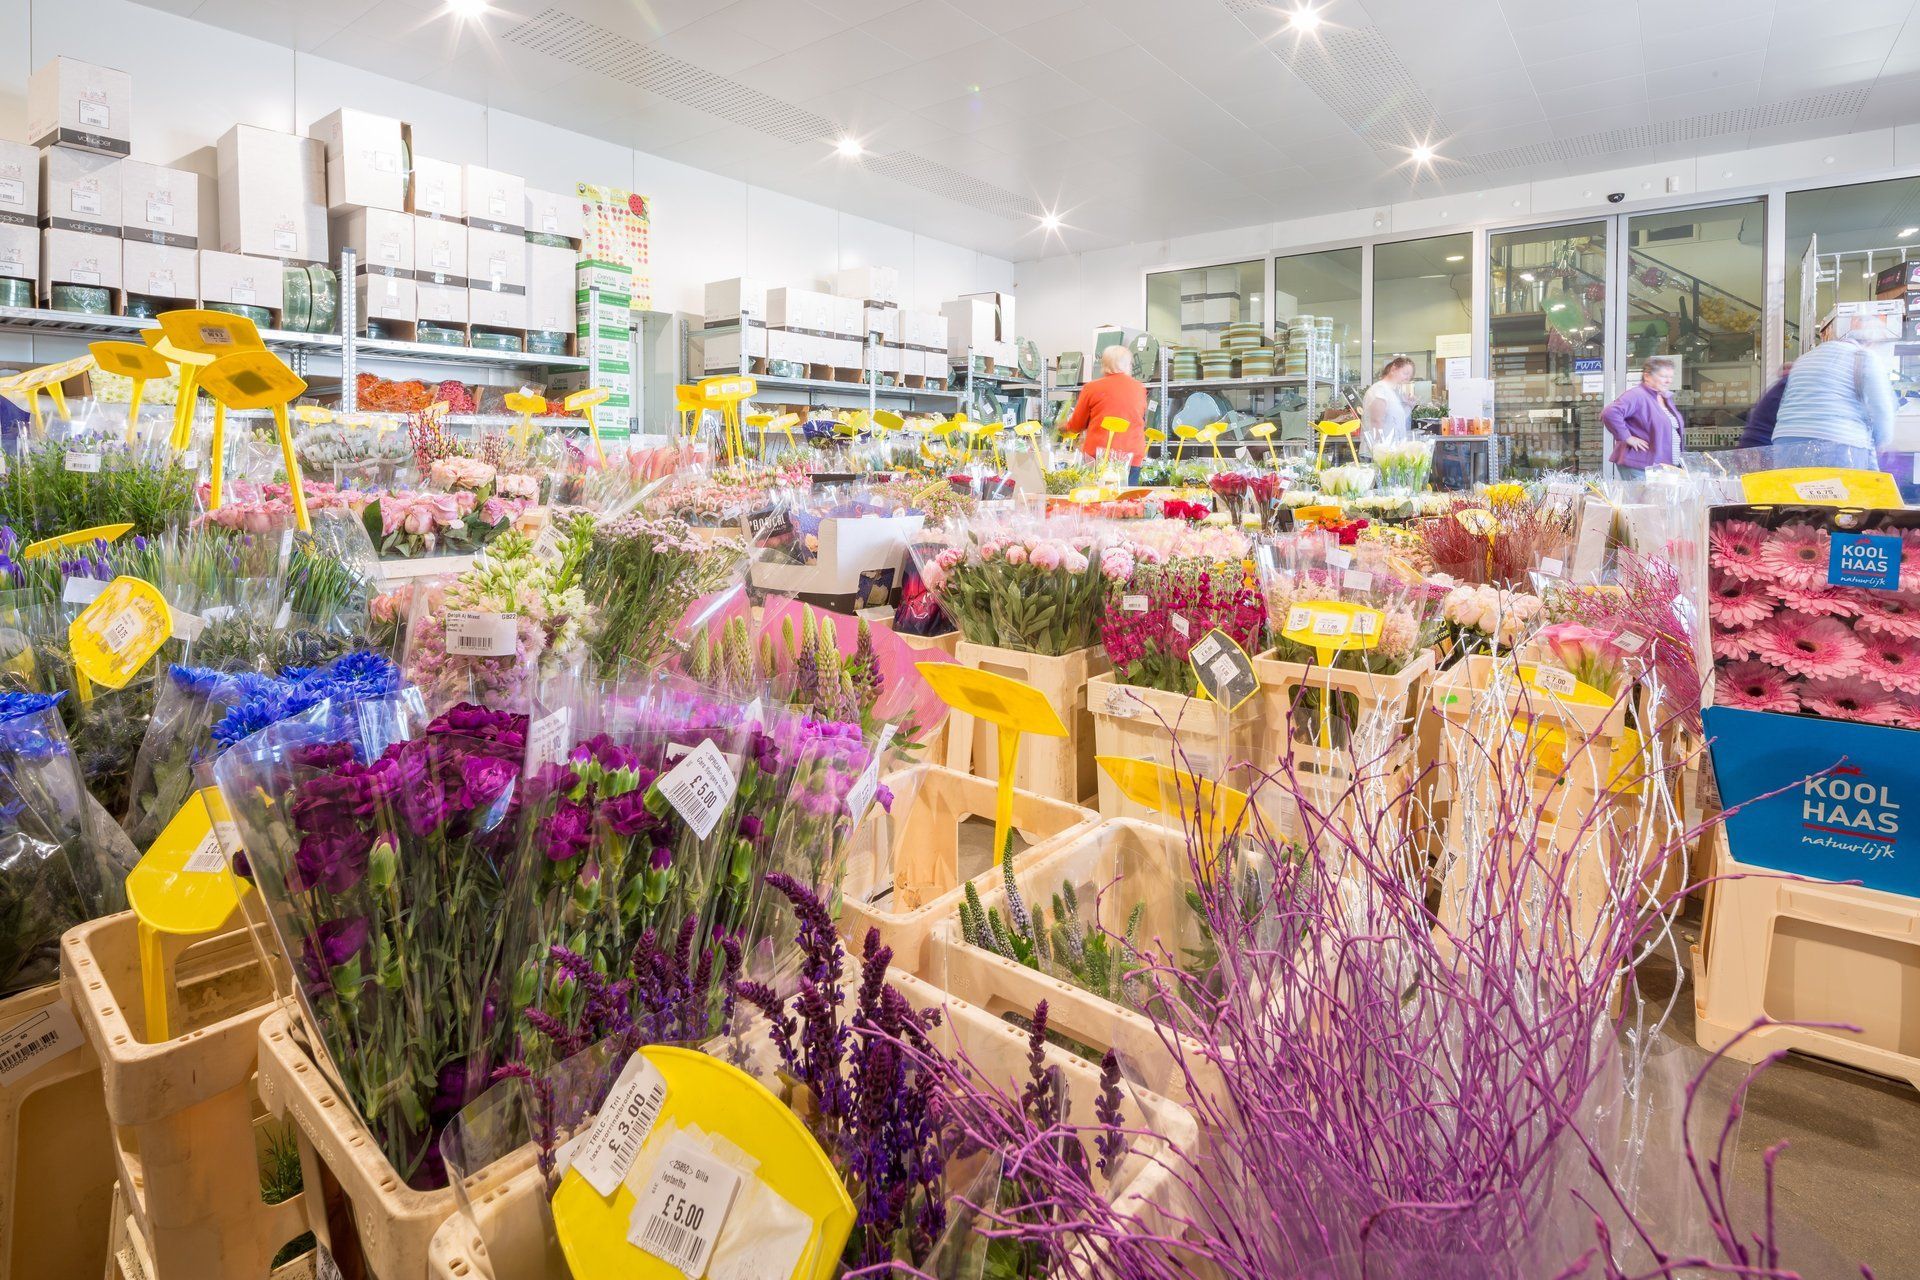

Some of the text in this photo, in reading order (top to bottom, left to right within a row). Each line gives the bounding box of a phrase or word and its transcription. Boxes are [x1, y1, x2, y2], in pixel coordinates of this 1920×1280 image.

[1841, 557, 1888, 573] HAAS
[1842, 544, 1888, 560] KOOL
[1840, 576, 1886, 588] natuurlijk
[690, 775, 718, 809] £ 5.00
[1804, 775, 1900, 809] KOOL
[1803, 800, 1899, 833] HAAS
[1801, 834, 1895, 860] natuurlijk
[609, 1095, 622, 1110] Trit
[608, 1093, 646, 1154] £ 3.00
[662, 1193, 704, 1231] £ 5.00
